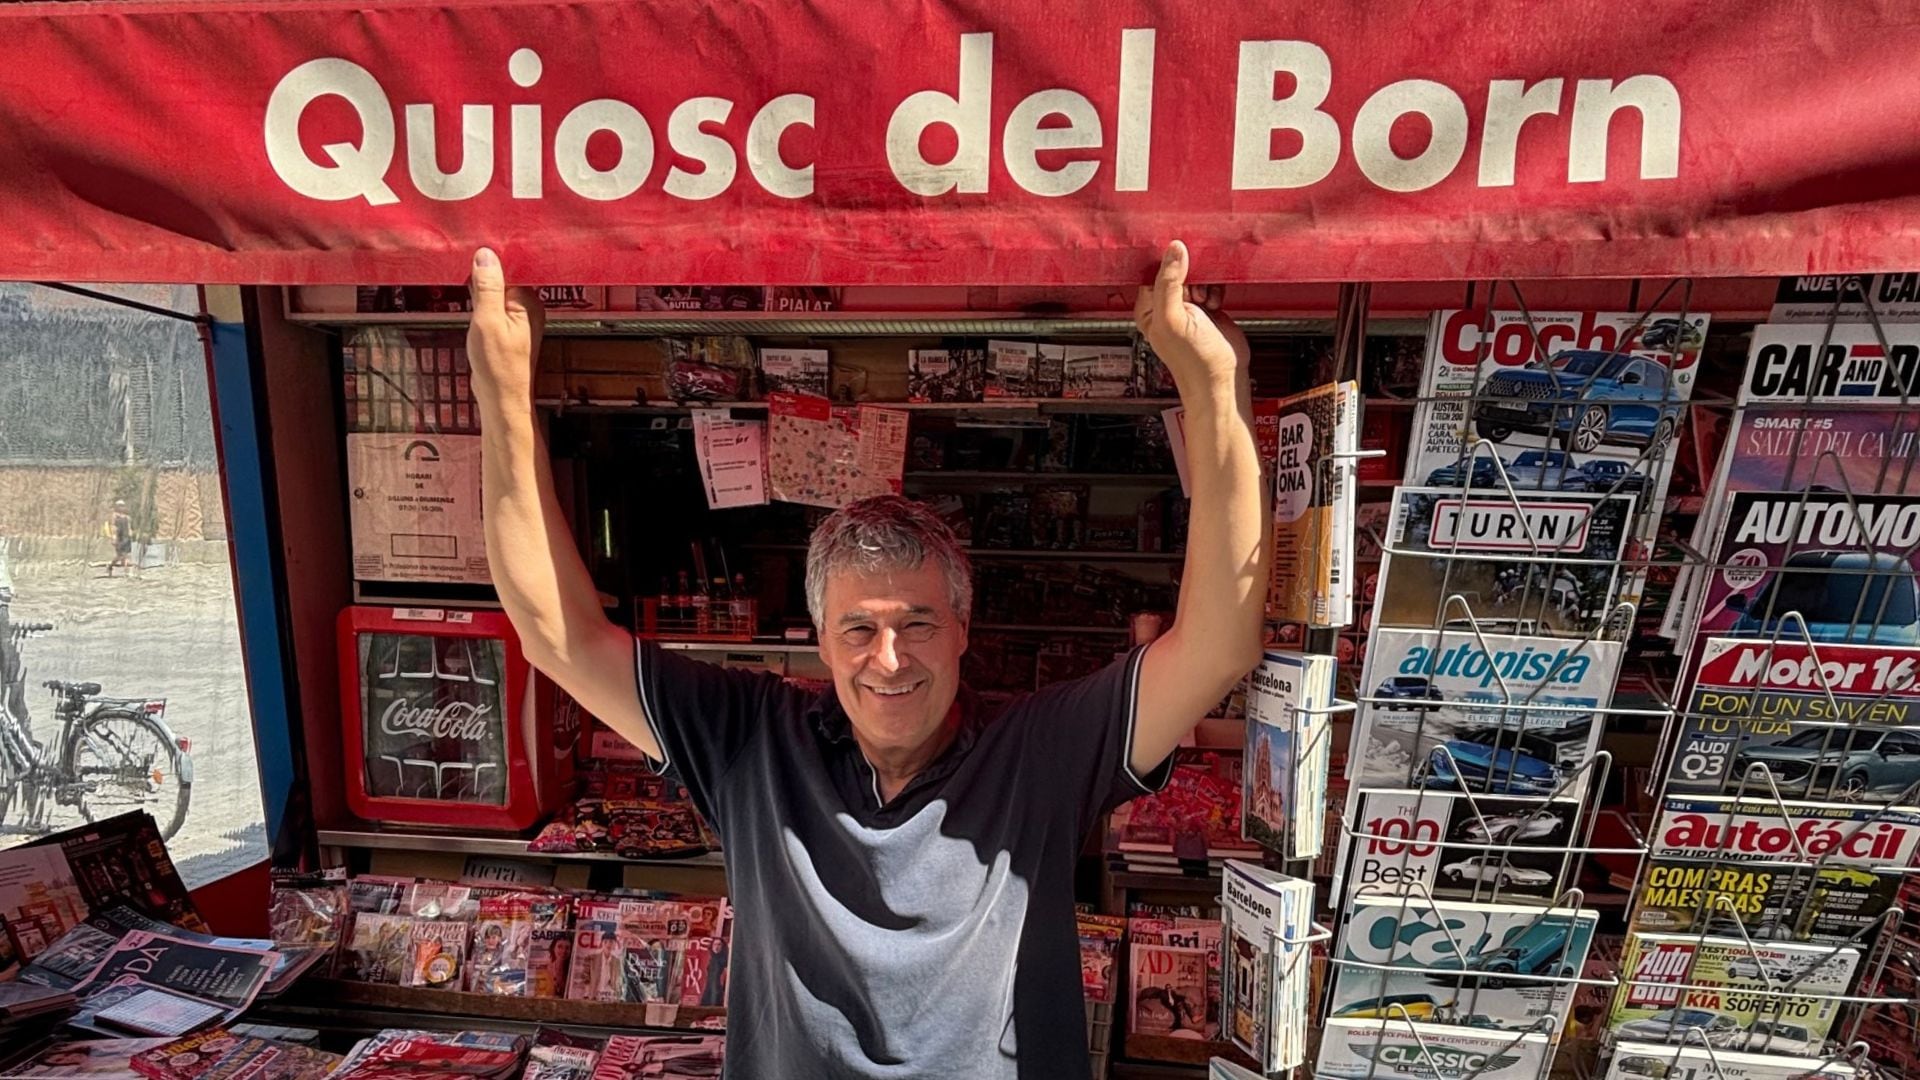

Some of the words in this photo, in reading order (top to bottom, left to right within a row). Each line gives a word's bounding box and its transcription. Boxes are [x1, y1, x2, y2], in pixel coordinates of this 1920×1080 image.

[264, 48, 815, 206] Quiosc
[885, 28, 1156, 197] del
[1231, 40, 1682, 192] Born
[1878, 272, 1920, 303] CA
[669, 301, 702, 310] BUTLER
[1750, 343, 1847, 397] CAR
[1843, 359, 1883, 382] AND
[1878, 344, 1920, 397] D
[1281, 423, 1305, 448] BAR
[1754, 417, 1813, 429] SMART
[1814, 418, 1834, 429] #5
[1747, 430, 1810, 456] SALTE
[1813, 431, 1851, 457] DEL
[1279, 450, 1302, 471] CEL
[1279, 470, 1306, 494] ONA
[1449, 512, 1578, 541] TURINI
[1399, 643, 1591, 688] autopista
[1729, 648, 1866, 690] Motor
[381, 698, 493, 741] Coca-Cola
[1700, 694, 1751, 713] PON
[1762, 697, 1802, 717] UN
[1806, 699, 1862, 719] SUV
[1868, 703, 1909, 723] EN
[1686, 740, 1730, 755] AUDI
[1680, 754, 1725, 779] Q3
[1367, 818, 1440, 857] 100
[1664, 814, 1907, 860] autofácil
[1360, 859, 1427, 885] Best
[1650, 866, 1772, 894] COMPRAS
[1227, 881, 1272, 919] Barcelone
[1644, 887, 1764, 913] MAESTRAS
[1346, 905, 1543, 967] car
[1139, 950, 1174, 975] AD
[1701, 946, 1727, 955] TEST
[1686, 994, 1720, 1009] KIA
[1723, 998, 1811, 1017] SORENTO
[1447, 1037, 1479, 1046] CENTURY
[1379, 1046, 1487, 1072] CLASSIC
[1407, 1066, 1436, 1075] SPORT
